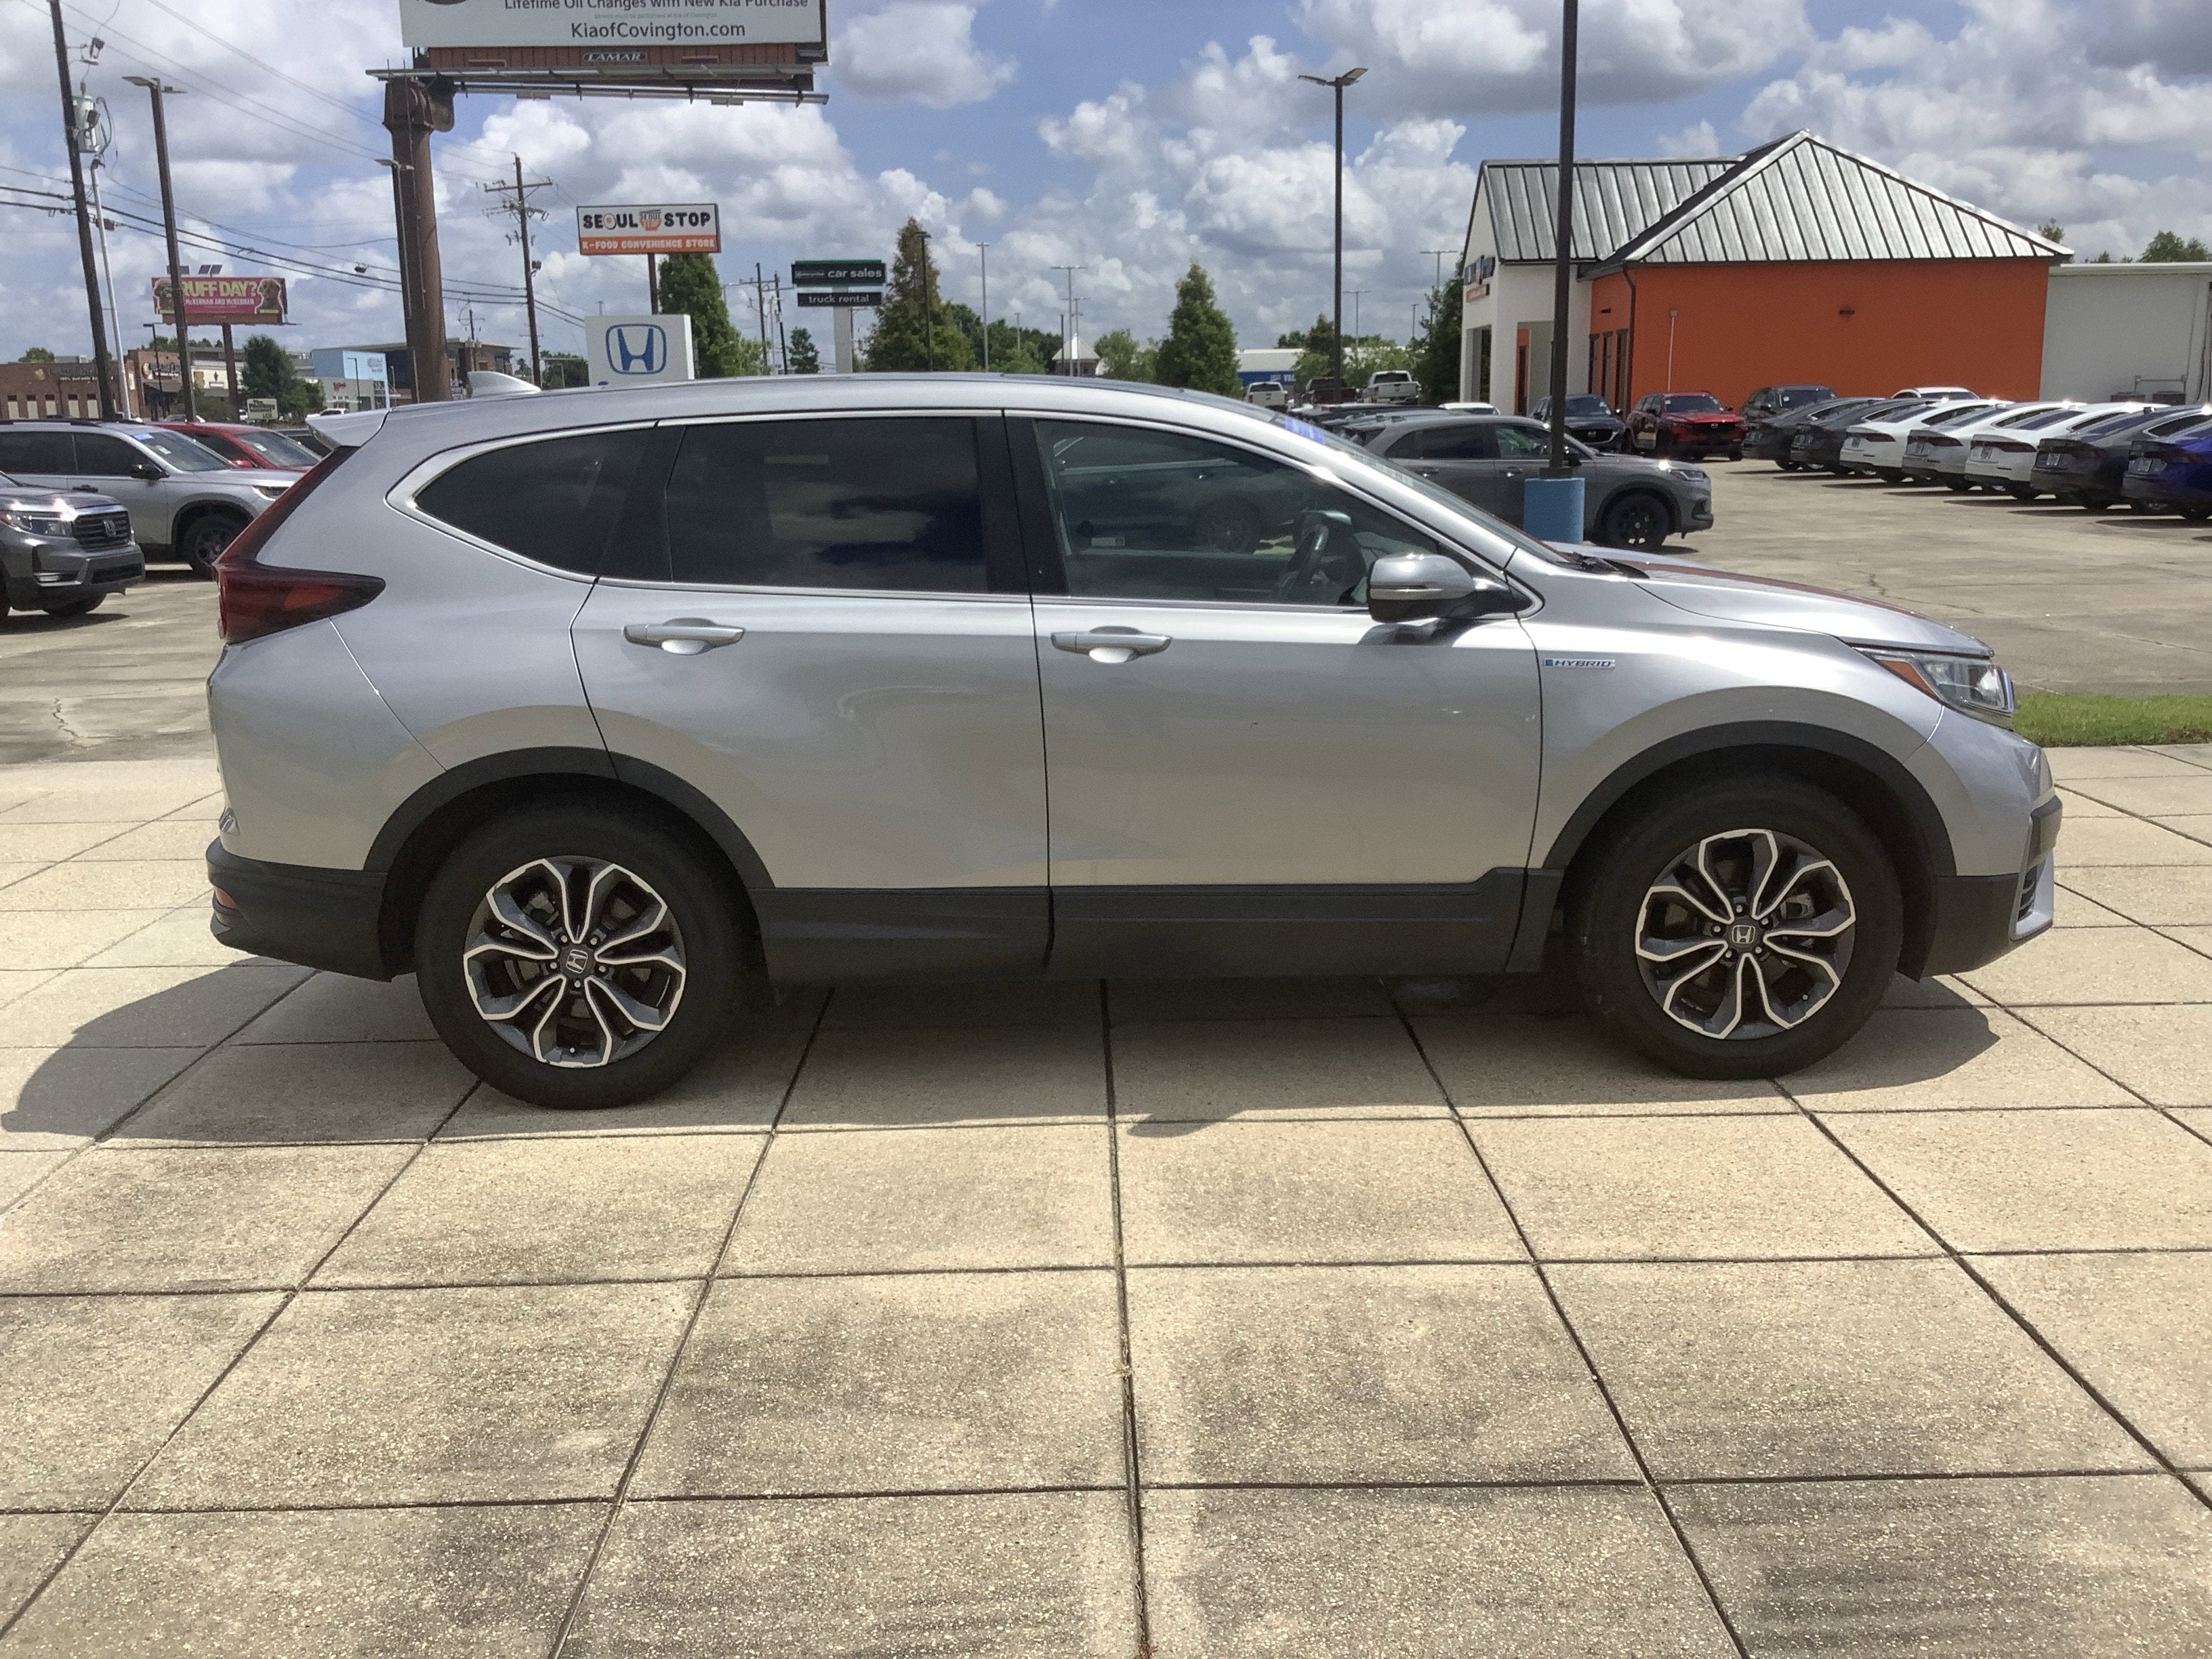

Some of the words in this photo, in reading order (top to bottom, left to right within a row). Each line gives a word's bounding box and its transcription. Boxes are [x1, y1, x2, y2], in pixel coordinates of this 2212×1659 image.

[504, 0, 560, 9] Lifetime
[588, 0, 647, 11] Changes
[571, 22, 745, 41] KiaofCovington.com
[587, 52, 640, 62] LAMAR
[664, 211, 711, 227] STOP
[621, 239, 682, 249] CONVENIENCE
[685, 238, 715, 247] STORE
[850, 268, 882, 278] sales
[218, 281, 258, 297] DAY?
[808, 294, 835, 303] truck
[838, 294, 869, 303] rental
